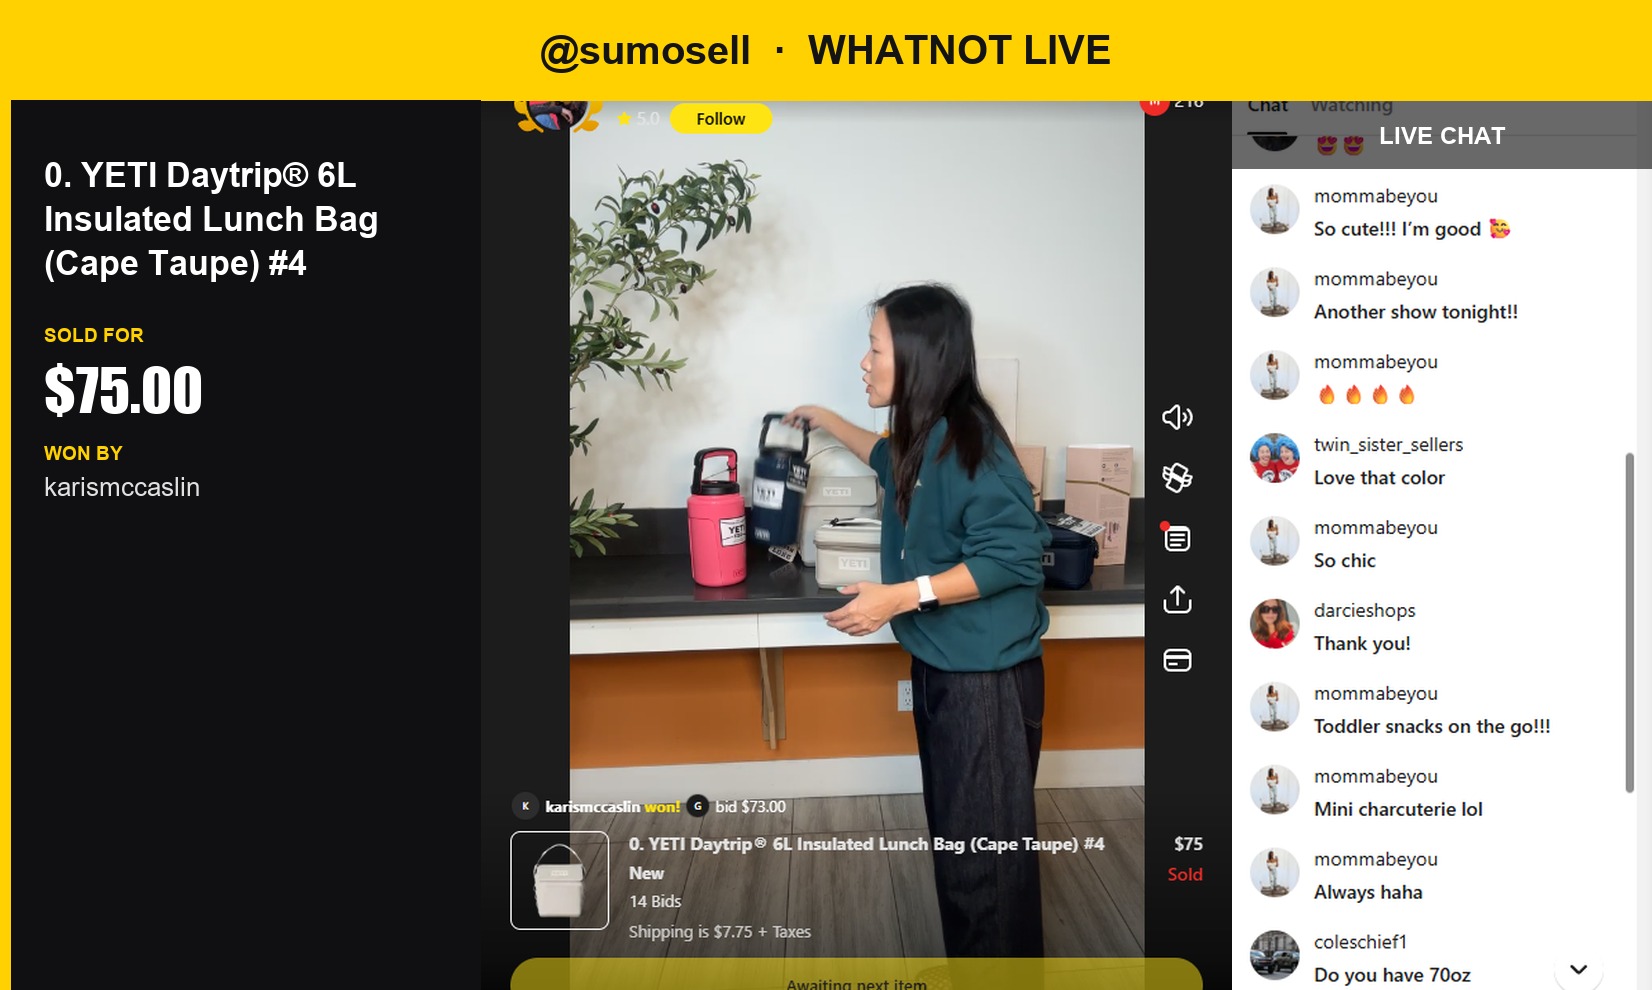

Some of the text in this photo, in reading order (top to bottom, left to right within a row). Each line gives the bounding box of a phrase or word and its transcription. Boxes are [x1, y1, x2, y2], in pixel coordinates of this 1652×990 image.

[1248, 101, 1288, 112] Chat
[1311, 101, 1393, 116] Watching
[1313, 187, 1437, 207] mommabeyou
[1314, 221, 1336, 236] So
[1341, 221, 1395, 236] cute!!!
[1435, 221, 1481, 240] good
[1313, 270, 1437, 290] mommabeyou
[1314, 304, 1517, 323] Another show tonight!!
[1313, 353, 1437, 373] mommabeyou
[1314, 437, 1463, 455] twin_sister_sellers
[1314, 470, 1445, 485] Love that color
[825, 488, 849, 496] YETI
[1313, 519, 1437, 539] mommabeyou
[840, 558, 867, 568] YETI
[1314, 553, 1376, 568] So chic
[1314, 603, 1416, 621] darcieshops
[1314, 636, 1410, 655] Thank you!
[1313, 685, 1437, 705] mommabeyou
[1314, 719, 1550, 737] Toddler snacks on the go!!!
[1313, 768, 1437, 788] mommabeyou
[1314, 802, 1482, 817] Mini charcuterie lol
[1313, 850, 1437, 870] mommabeyou
[1314, 885, 1423, 903] Always haha
[1314, 934, 1406, 950] coleschief1
[1314, 967, 1471, 986] Do you have 70oz
